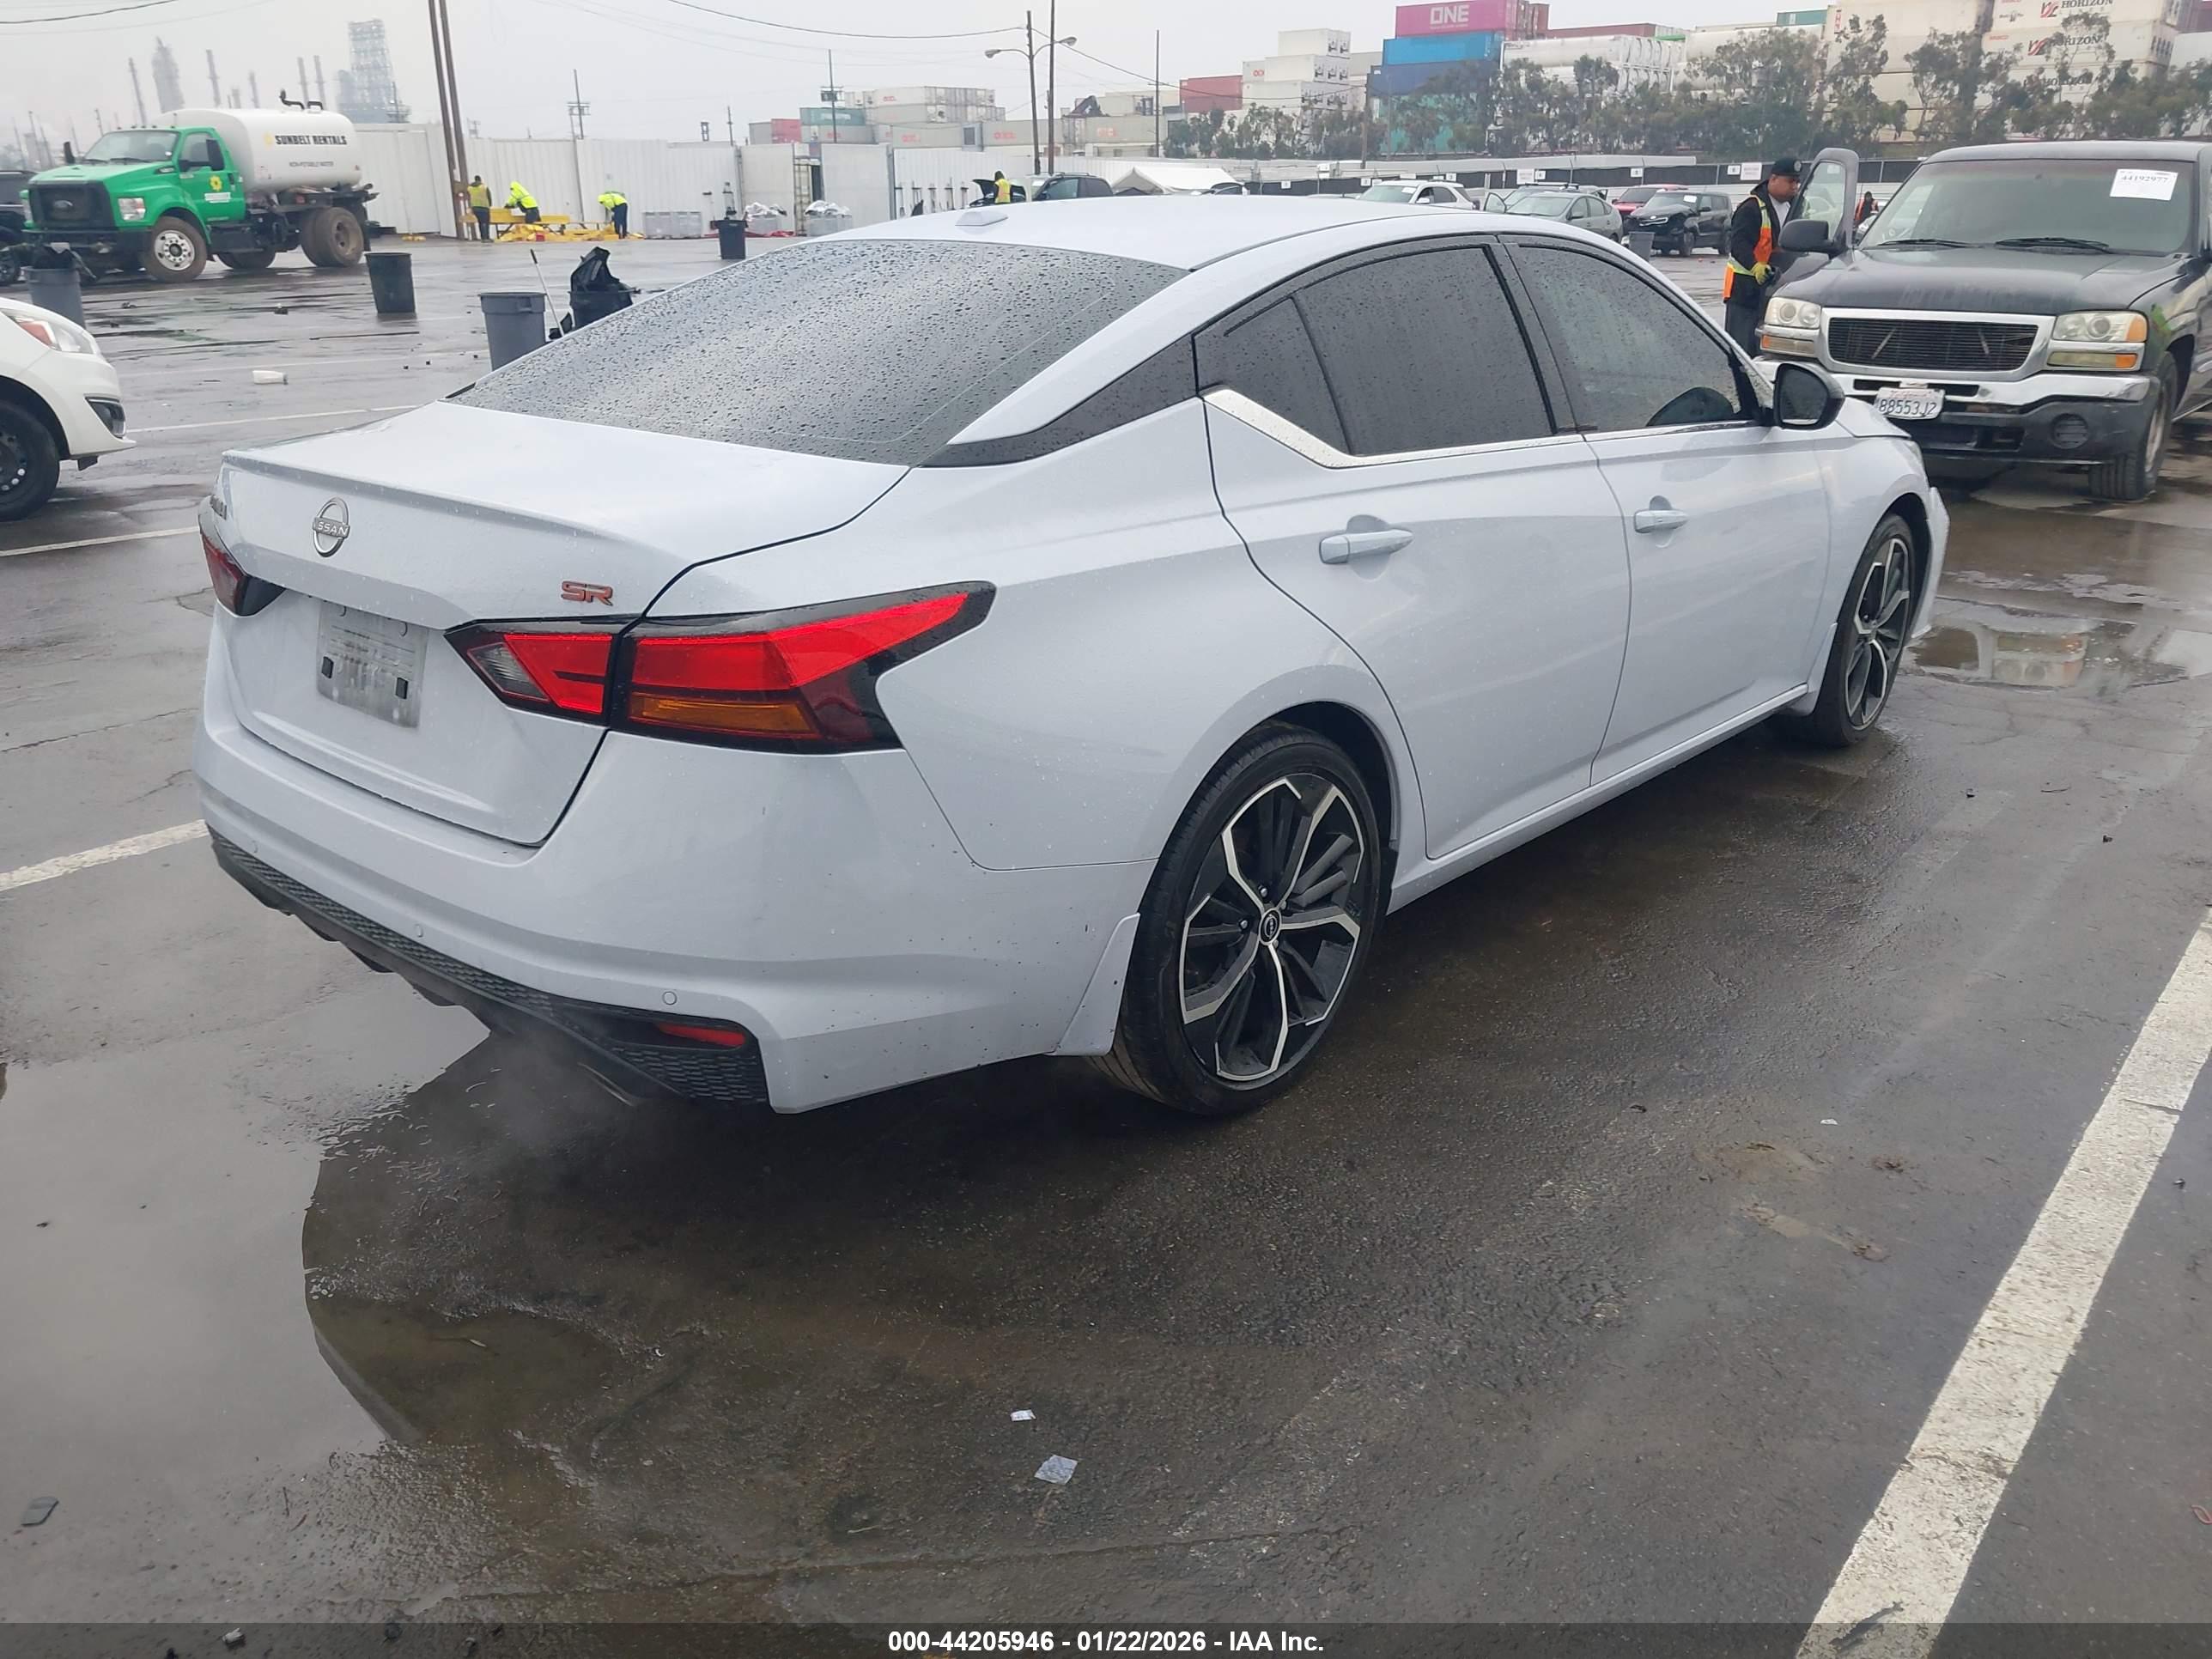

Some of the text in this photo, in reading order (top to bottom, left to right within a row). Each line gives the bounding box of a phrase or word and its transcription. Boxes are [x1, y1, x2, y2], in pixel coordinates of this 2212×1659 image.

[2061, 0, 2113, 9] HORIZON
[1430, 4, 1469, 25] ONE
[275, 135, 347, 145] SUNBELT RENTALS
[2121, 174, 2168, 183] 44192977
[1878, 398, 1937, 416] 88553J2
[561, 581, 613, 606] SR
